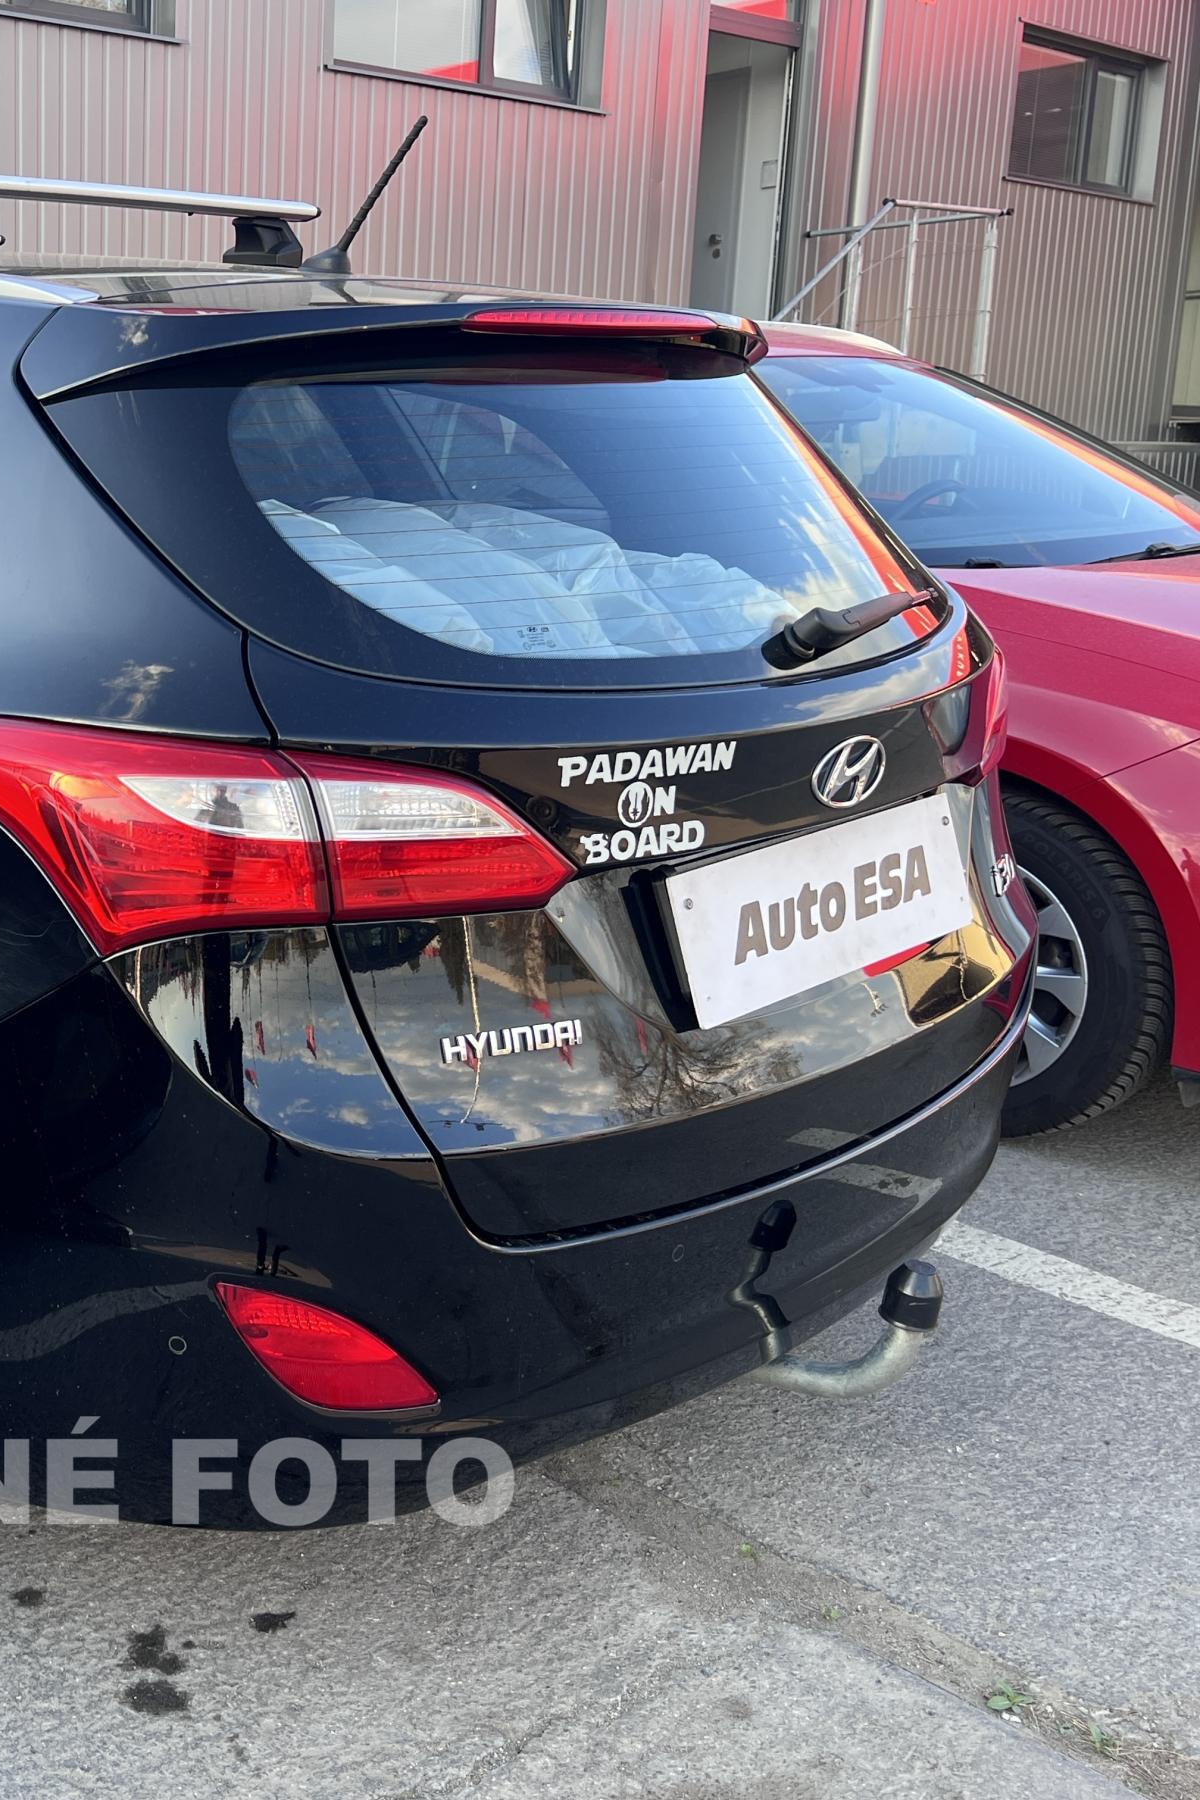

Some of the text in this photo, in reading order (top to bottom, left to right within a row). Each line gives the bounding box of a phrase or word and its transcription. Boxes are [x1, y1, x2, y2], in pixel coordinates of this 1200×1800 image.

[557, 741, 737, 788] PADAWAN
[617, 781, 676, 828] ON
[580, 820, 705, 864] BOARD
[734, 845, 931, 966] Auto ESA
[441, 1019, 583, 1064] HYUNDAI
